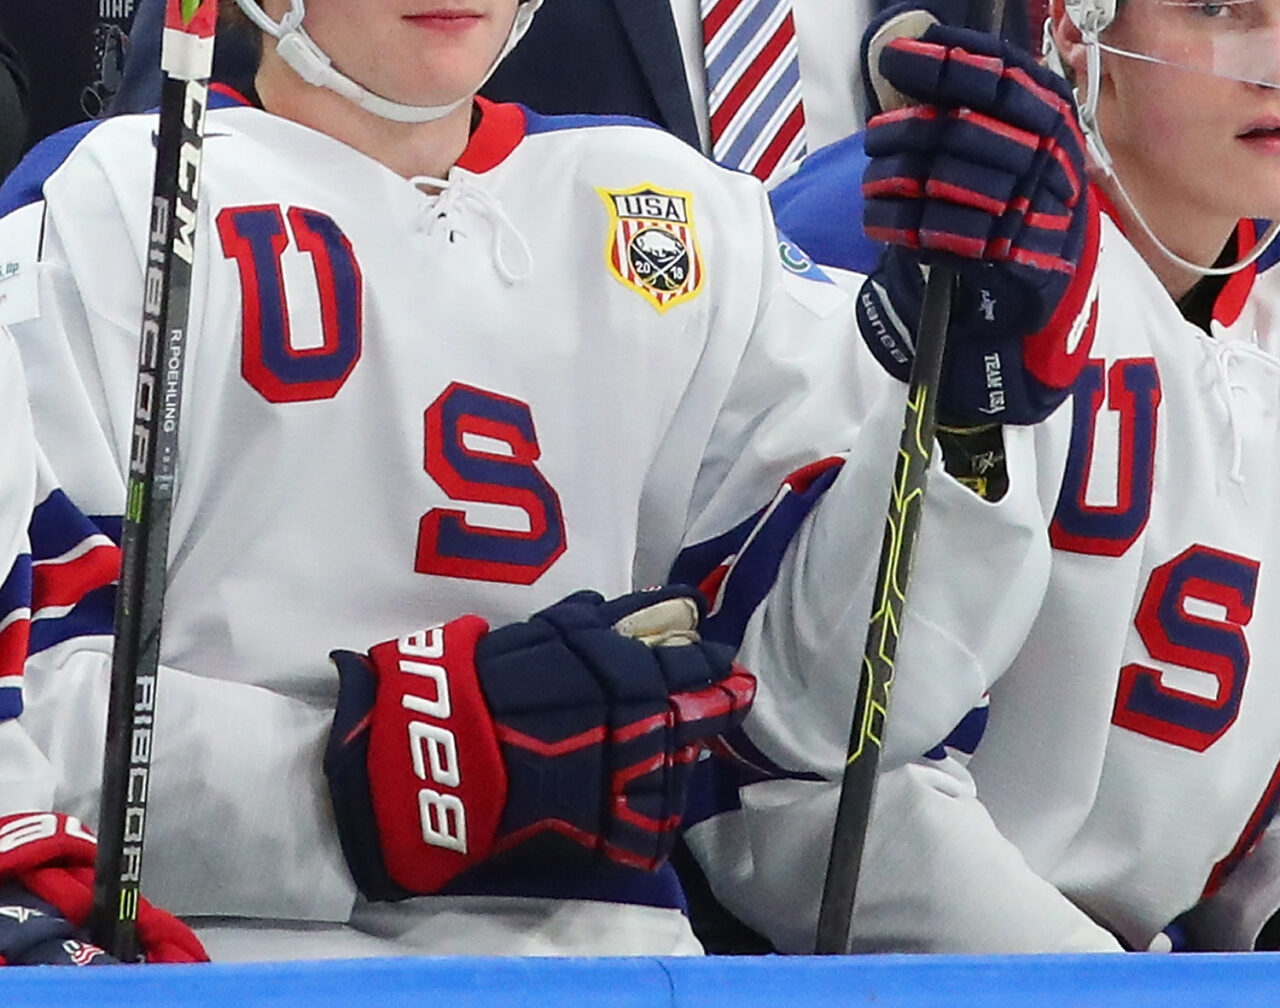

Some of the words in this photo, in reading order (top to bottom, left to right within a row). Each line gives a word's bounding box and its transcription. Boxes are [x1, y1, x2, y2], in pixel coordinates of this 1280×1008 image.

[173, 79, 209, 265] CCM
[625, 196, 681, 221] USA
[634, 260, 650, 274] 20
[131, 195, 170, 475] RIBCOR
[984, 352, 1003, 389] TEAM
[120, 675, 155, 883] RIBCOR
